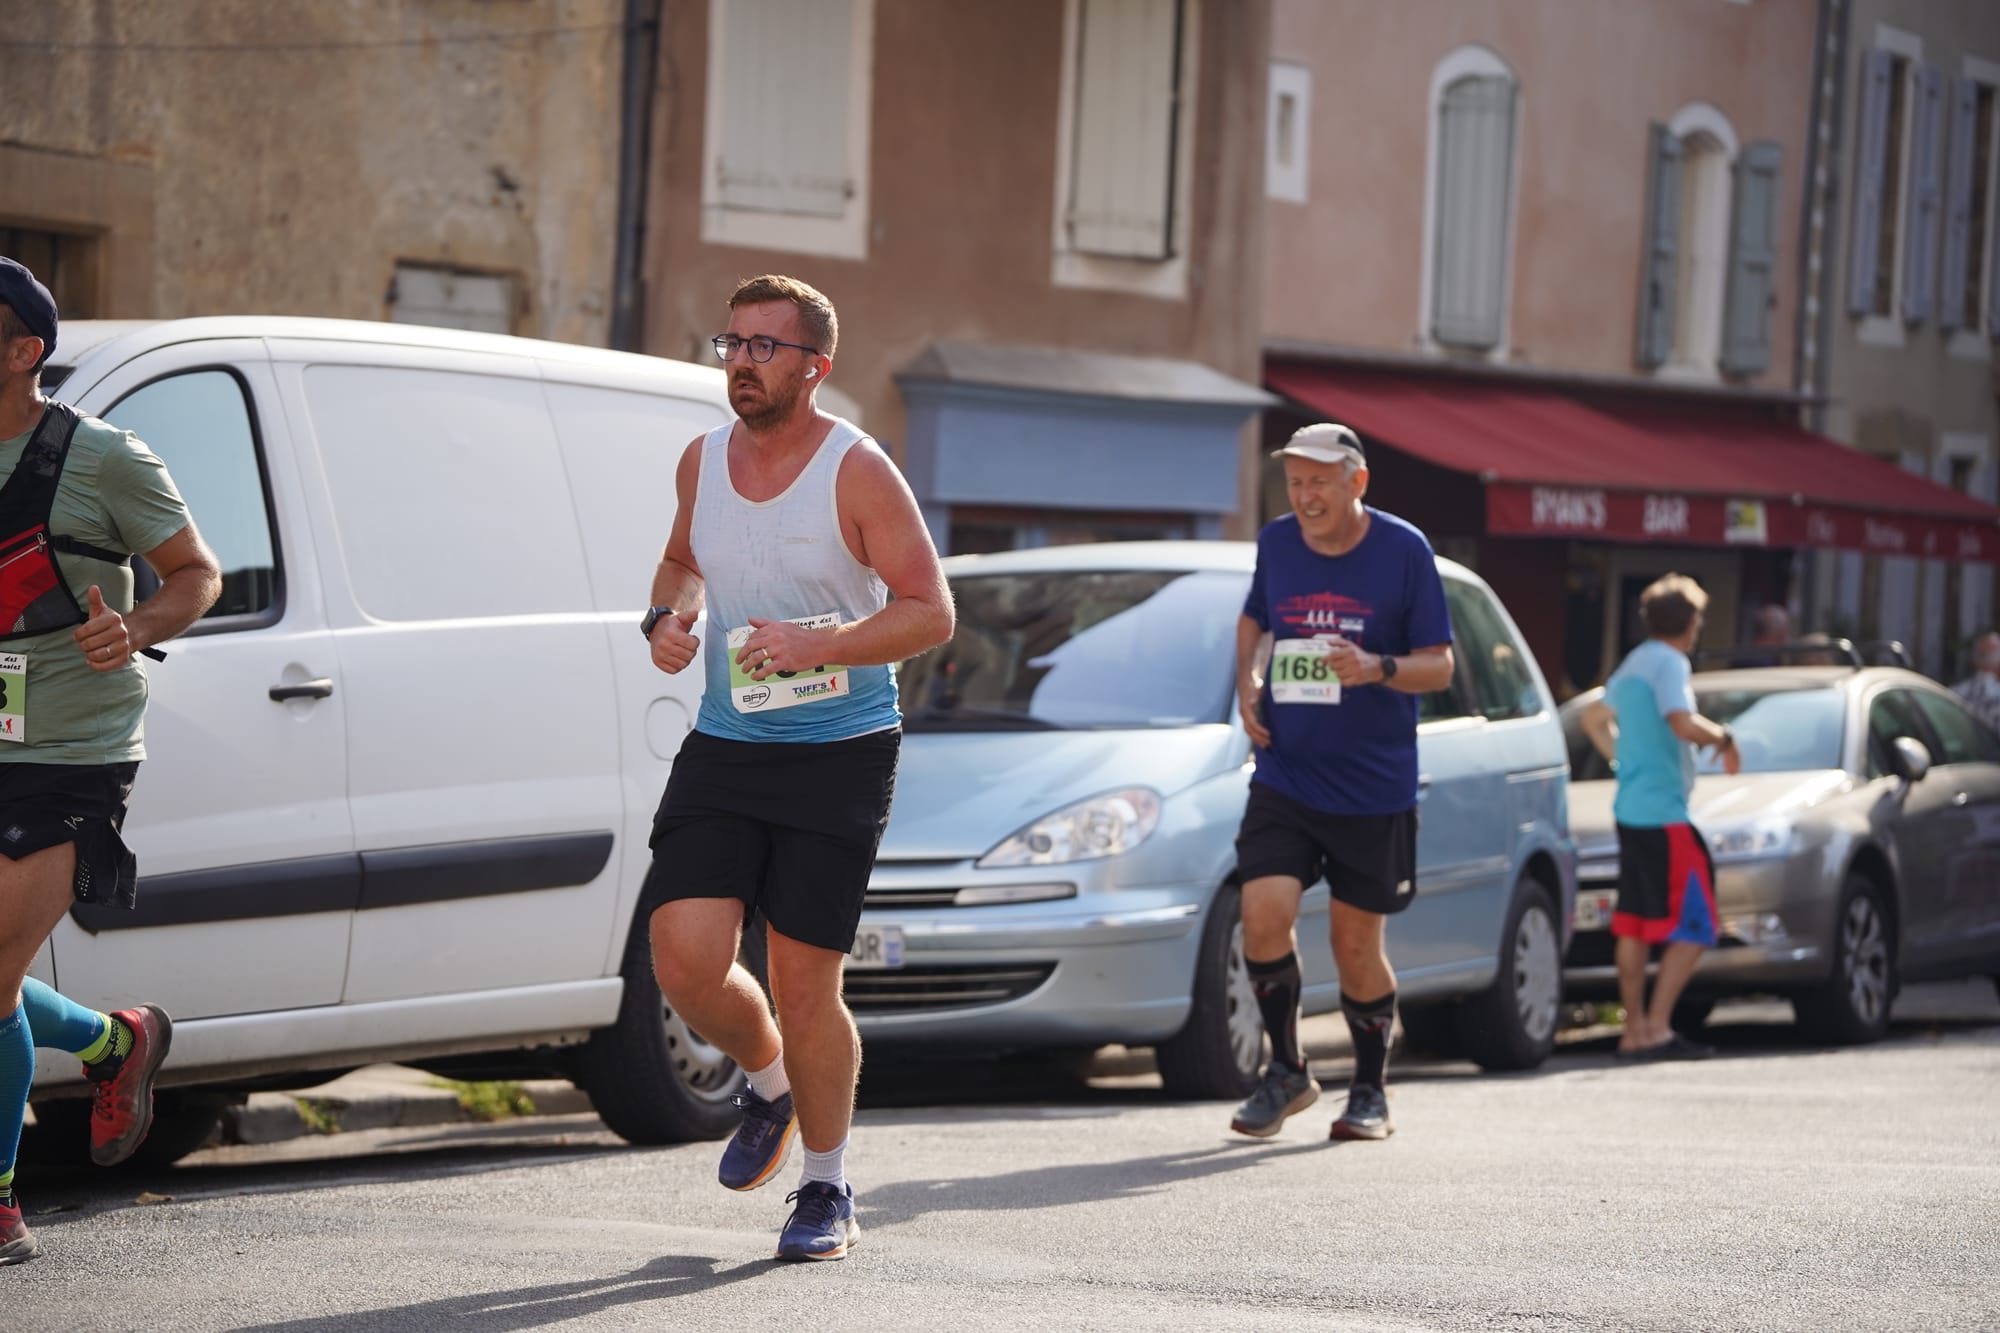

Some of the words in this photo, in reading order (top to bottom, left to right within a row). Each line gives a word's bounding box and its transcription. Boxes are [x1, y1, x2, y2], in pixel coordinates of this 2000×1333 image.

[1532, 486, 1608, 529] RYAN'S
[1642, 495, 1689, 535] BAR
[1279, 656, 1328, 681] 168
[742, 692, 767, 703] BFP
[792, 682, 827, 695] TUFF'S
